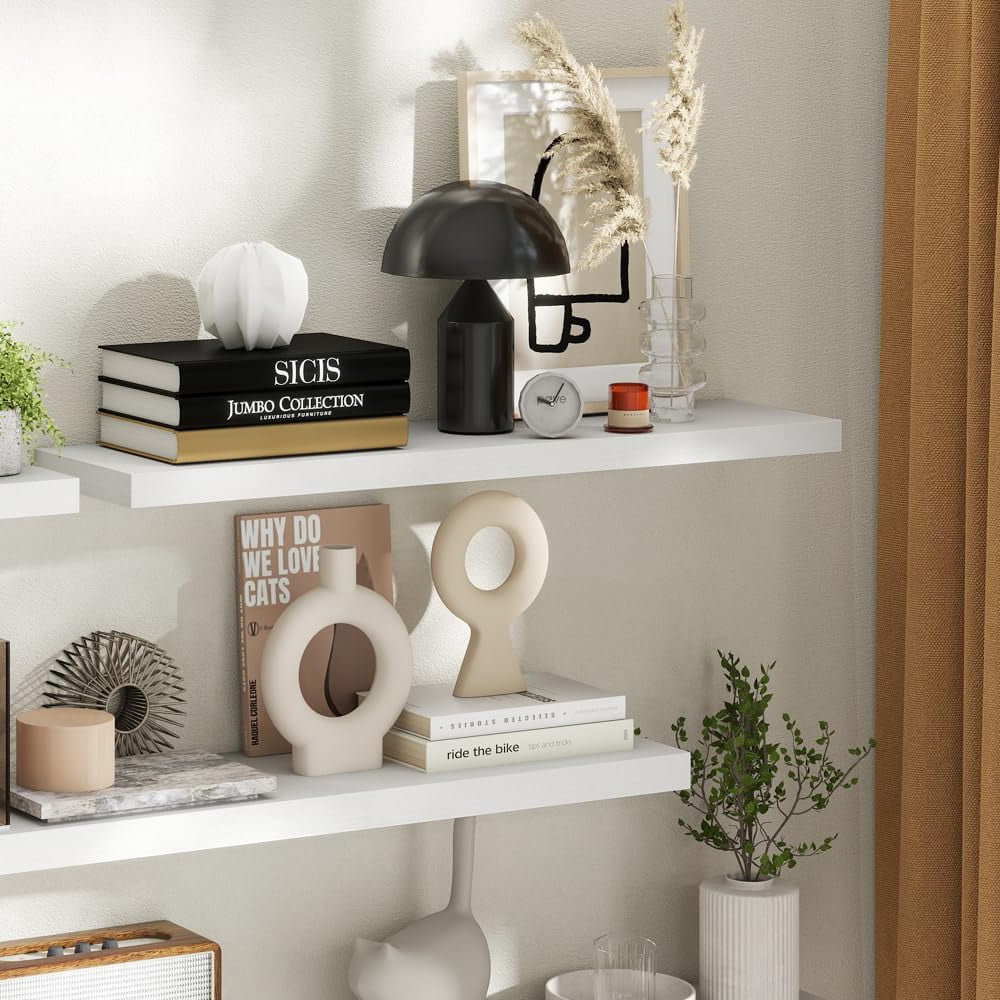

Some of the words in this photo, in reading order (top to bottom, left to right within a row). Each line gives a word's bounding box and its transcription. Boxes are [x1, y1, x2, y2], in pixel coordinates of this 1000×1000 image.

[274, 357, 341, 386] SICIS
[227, 399, 275, 420] JUMBO
[279, 393, 365, 412] COLLECTION
[259, 413, 295, 421] LUXURIOUS
[240, 516, 287, 550] WHY
[293, 514, 321, 545] DO
[242, 550, 273, 579] WE
[277, 545, 320, 575] LOVE
[244, 577, 291, 608] CATS
[249, 679, 258, 716] CORLEONE
[250, 717, 259, 746] RAQUEL
[450, 718, 496, 730] STORIES
[504, 712, 556, 723] SELECTED
[446, 748, 470, 760] ride
[473, 745, 492, 757] the
[495, 743, 520, 755] bike
